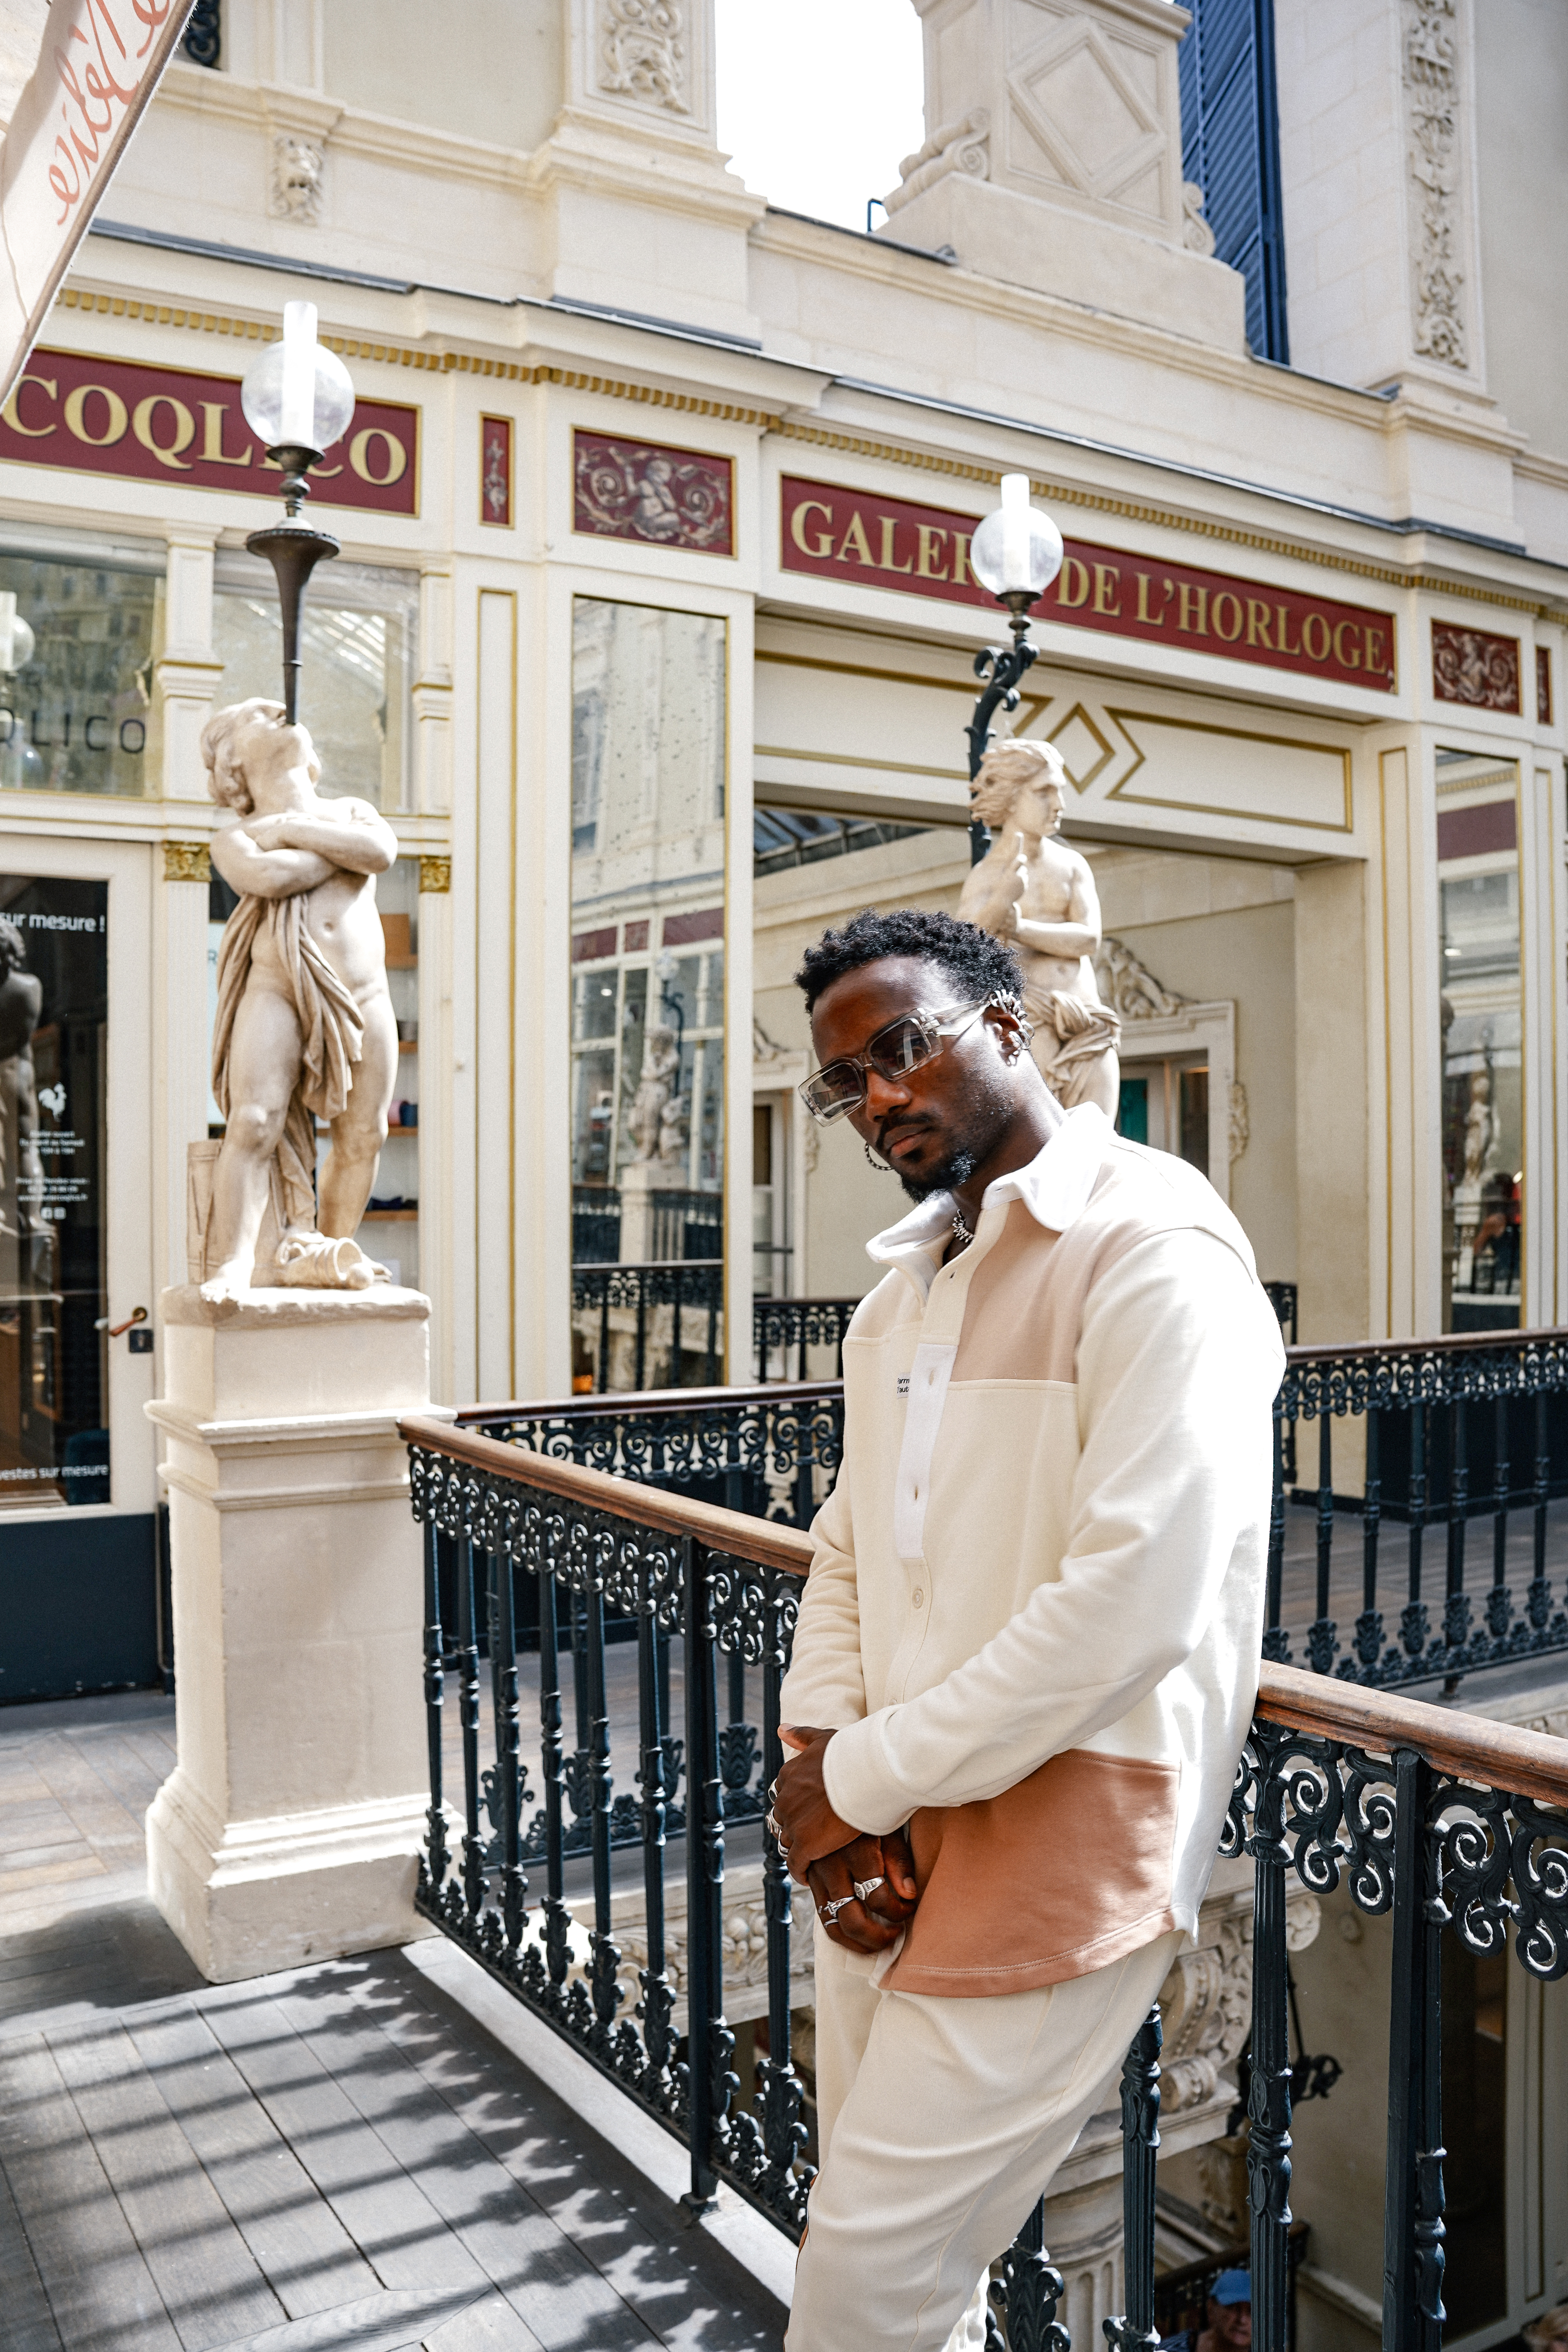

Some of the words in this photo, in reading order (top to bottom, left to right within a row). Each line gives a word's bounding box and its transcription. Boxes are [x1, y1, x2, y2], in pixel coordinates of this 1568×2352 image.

[1, 374, 407, 486] COQLO
[790, 500, 986, 590] GALER
[1056, 556, 1122, 617] DE
[1134, 571, 1388, 675] L'HORLOGE
[29, 914, 97, 933] mesure
[0, 1466, 38, 1481] estes
[38, 1467, 60, 1479] sur
[61, 1464, 109, 1477] mesure
